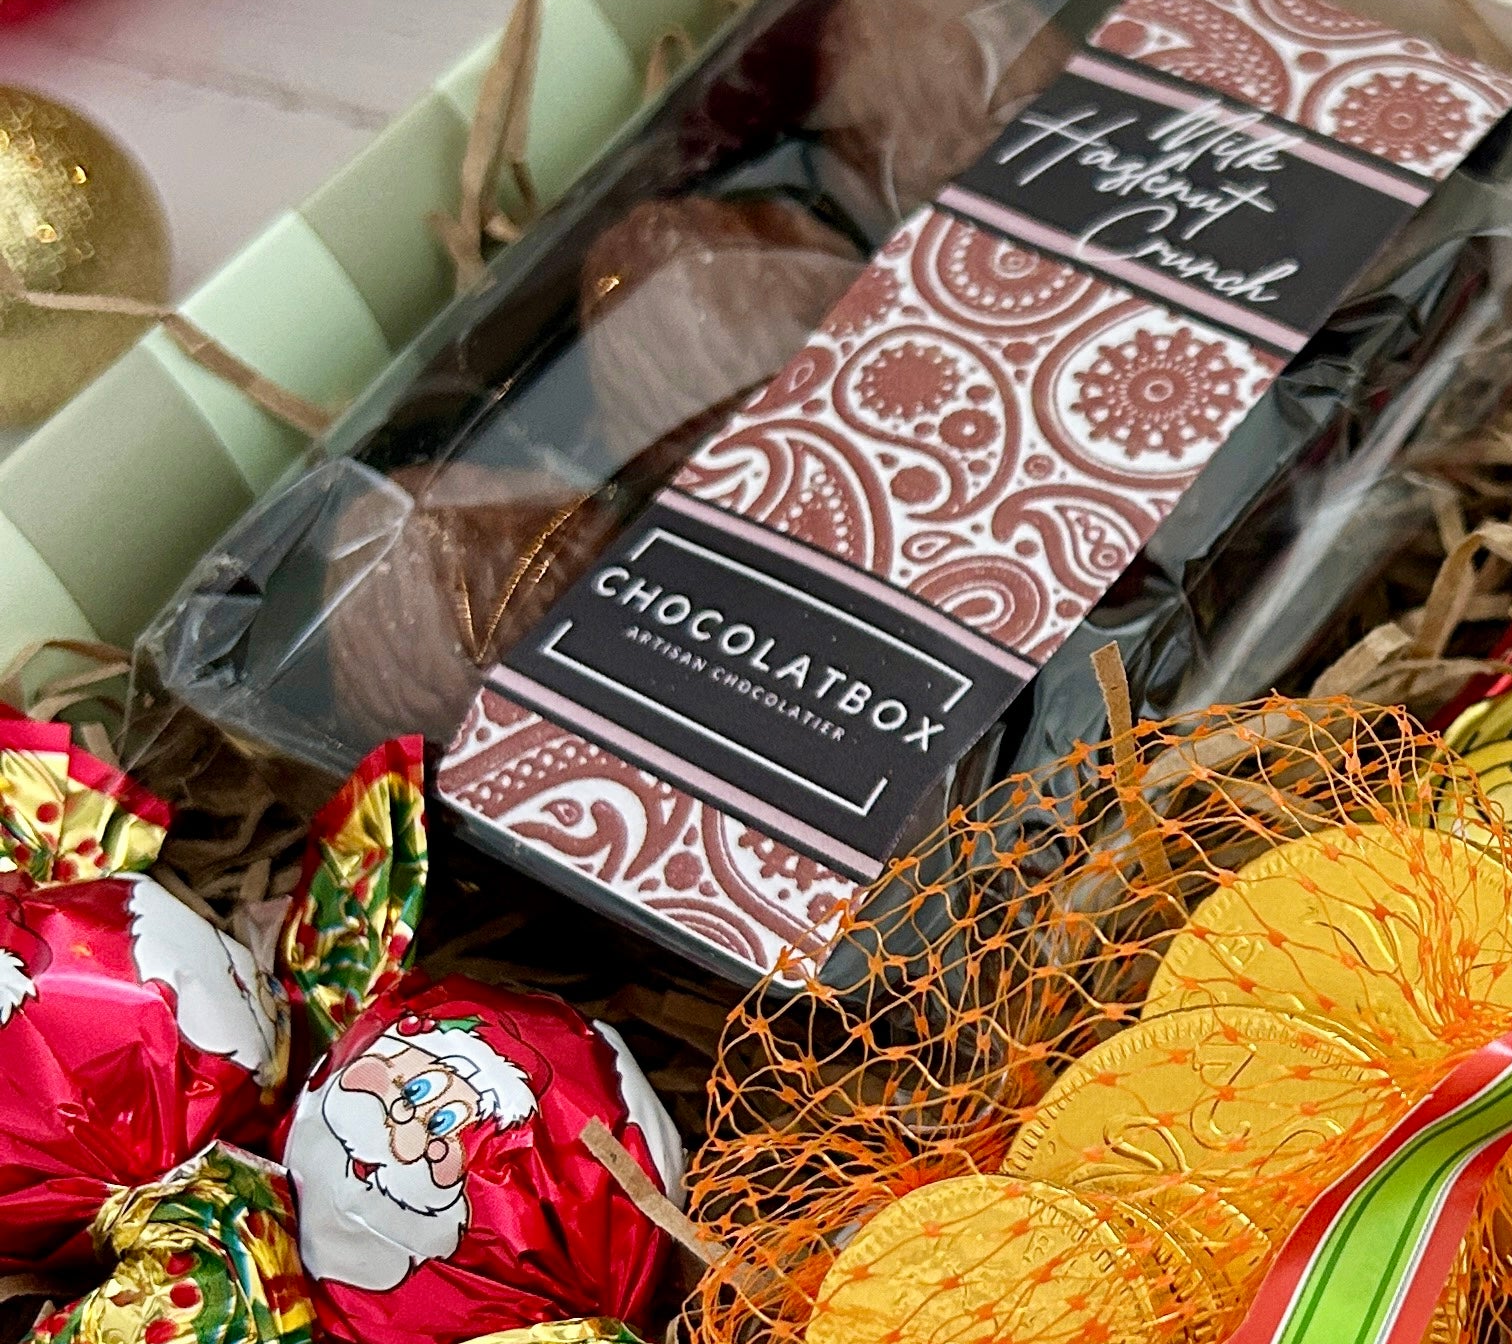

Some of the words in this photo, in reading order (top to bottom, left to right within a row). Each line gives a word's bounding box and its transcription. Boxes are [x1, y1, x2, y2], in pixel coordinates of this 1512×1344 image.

[1148, 97, 1304, 174] Milk
[1077, 206, 1298, 302] Crunch
[595, 565, 945, 752] CHOCOLATBOX
[624, 624, 707, 672] ARTISAN
[710, 665, 847, 742] CHOCOLATIER
